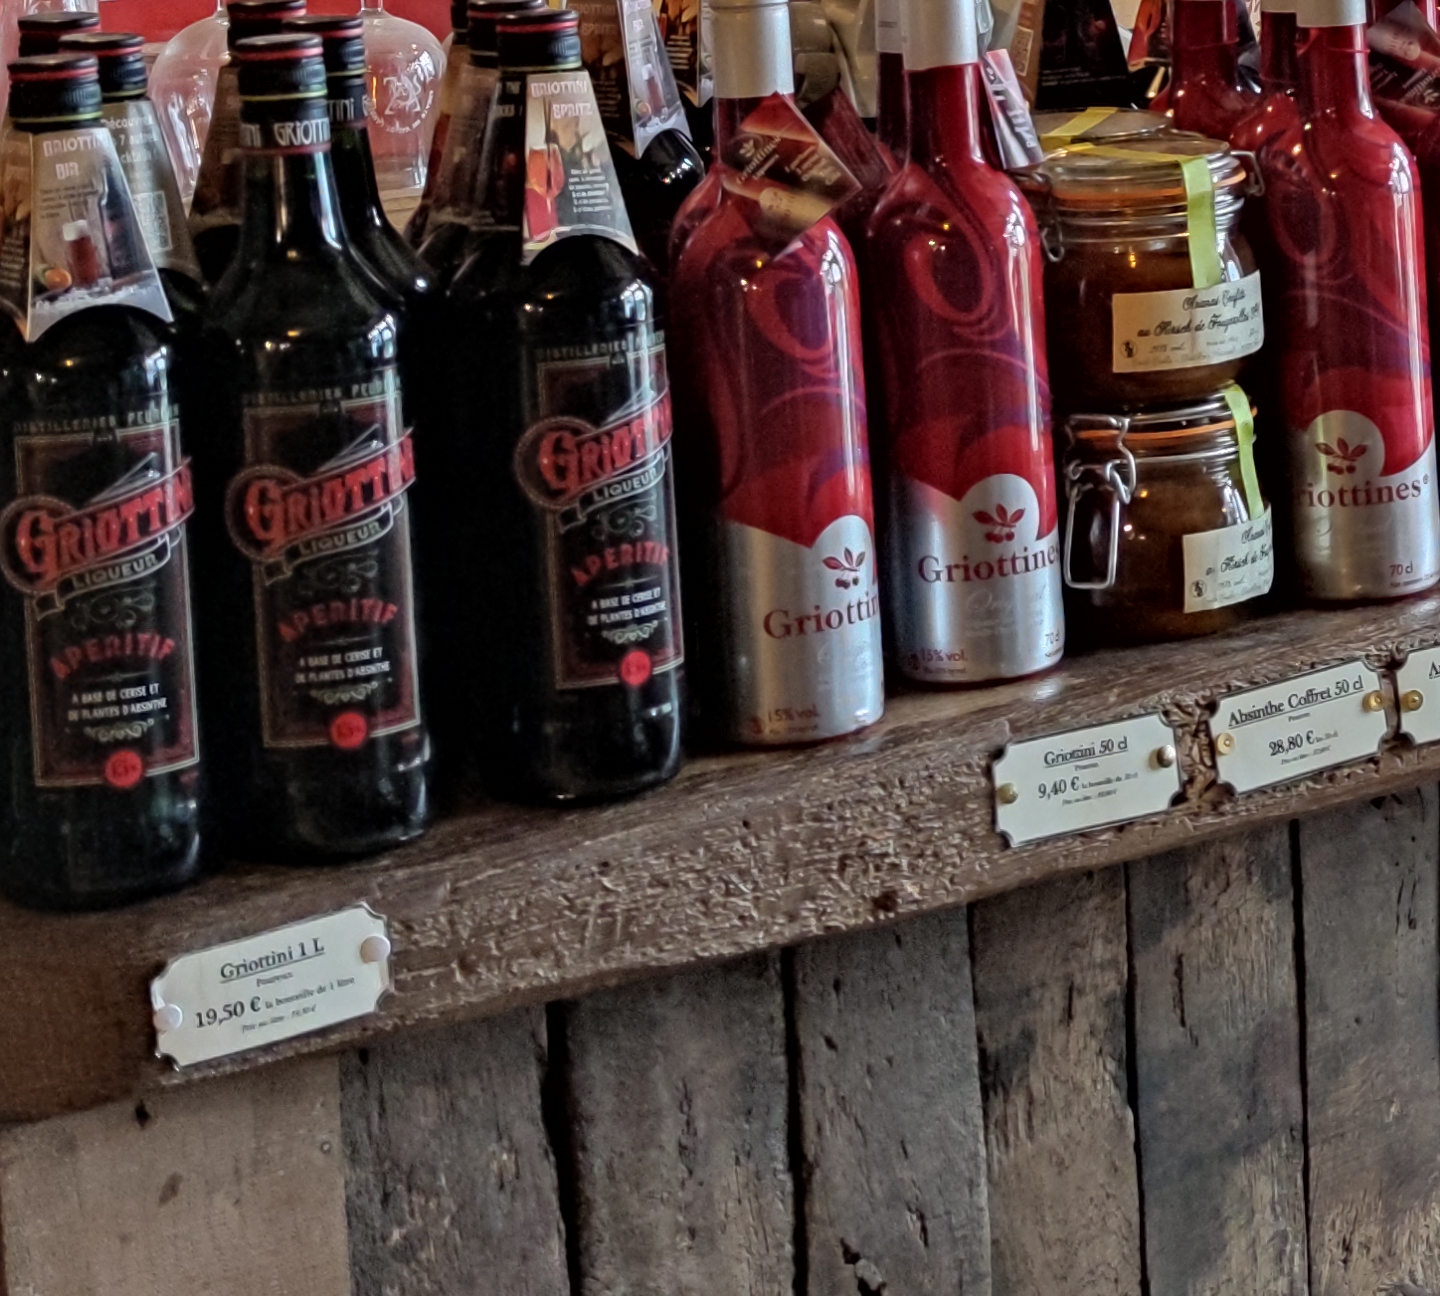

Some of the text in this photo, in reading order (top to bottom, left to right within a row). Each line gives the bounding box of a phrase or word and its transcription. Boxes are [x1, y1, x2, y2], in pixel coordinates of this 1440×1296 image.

[552, 101, 593, 120] SPRITZ
[297, 520, 382, 556] LIQUEUR
[70, 552, 158, 589] LIQUEUR
[1389, 561, 1414, 576] 70 cl
[50, 632, 176, 680] APERITIF
[1228, 675, 1365, 728] Absinthe Coffret 50 cl
[1044, 735, 1129, 767] Griottini 50 cl
[1268, 729, 1316, 756] 28,80 €
[1037, 775, 1081, 801] 9,40 €
[220, 936, 326, 982] Griottini 1 L
[194, 999, 246, 1030] 19,50
[249, 994, 263, 1013] €
[316, 984, 328, 996] de
